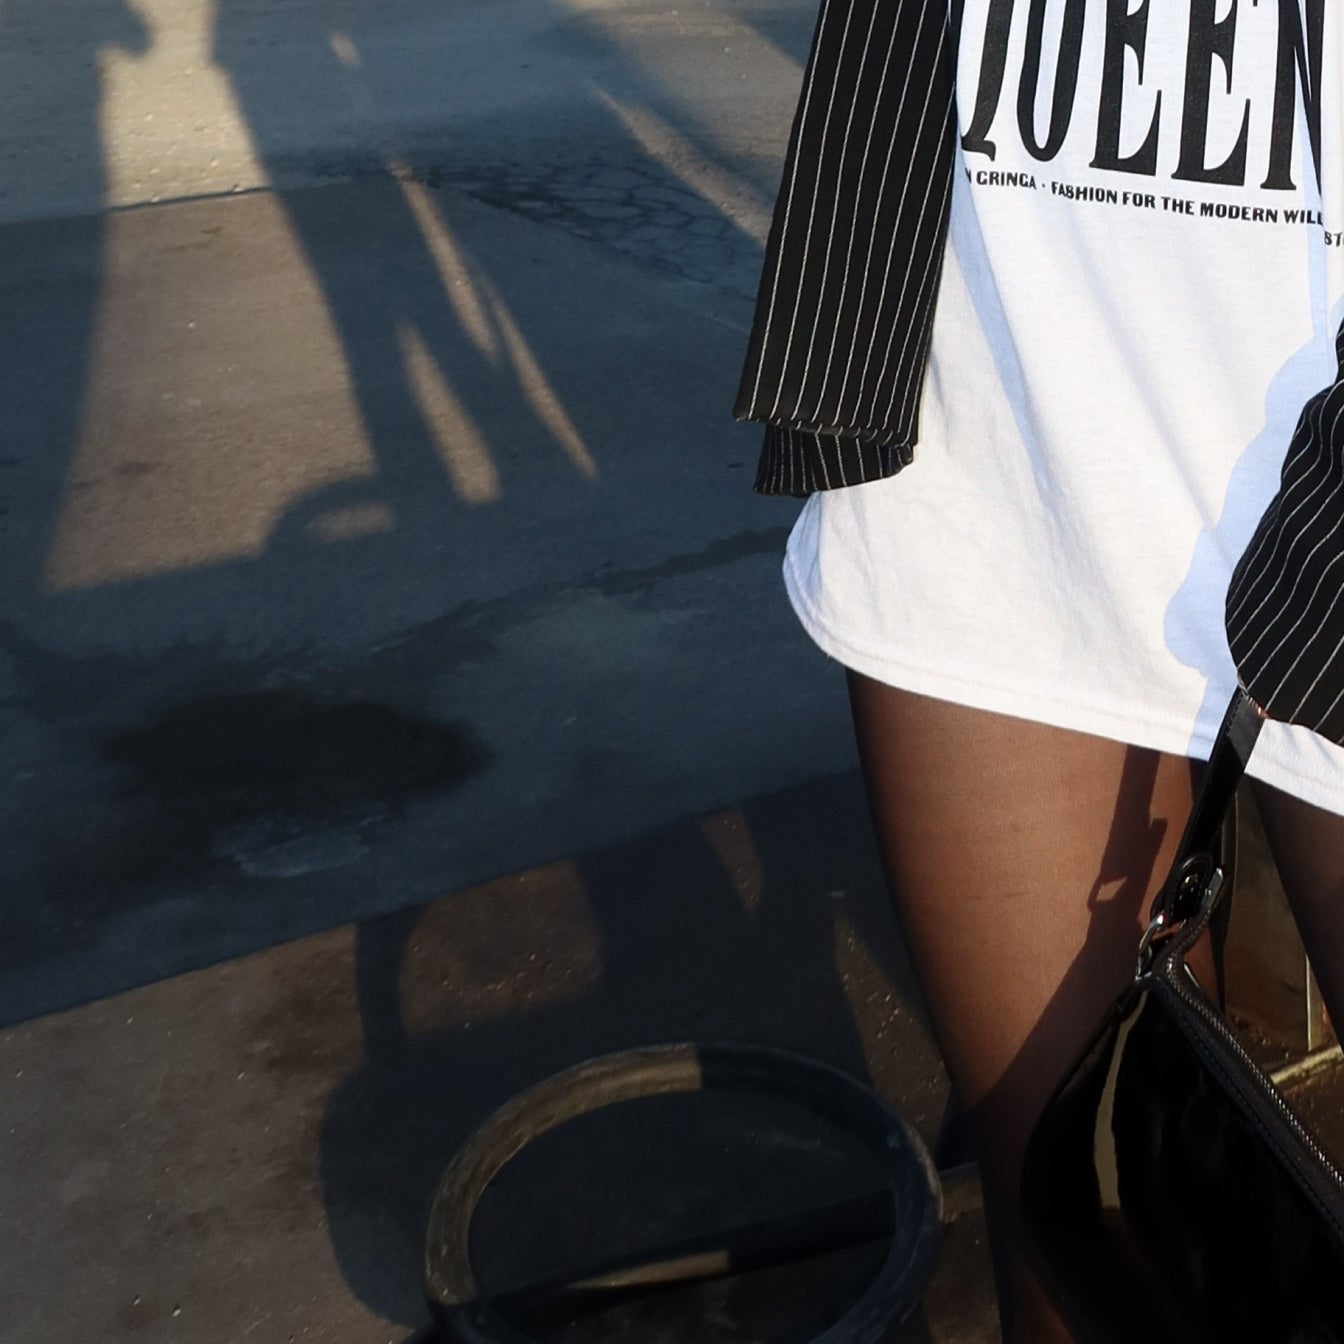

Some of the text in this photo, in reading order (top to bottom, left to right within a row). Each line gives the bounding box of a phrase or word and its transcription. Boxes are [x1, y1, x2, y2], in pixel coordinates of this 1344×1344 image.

[976, 170, 1037, 190] GRINGA
[1051, 181, 1118, 205] FASHION
[1122, 191, 1156, 209] FOR
[1160, 196, 1195, 216] THE
[1200, 202, 1279, 224] MODERN
